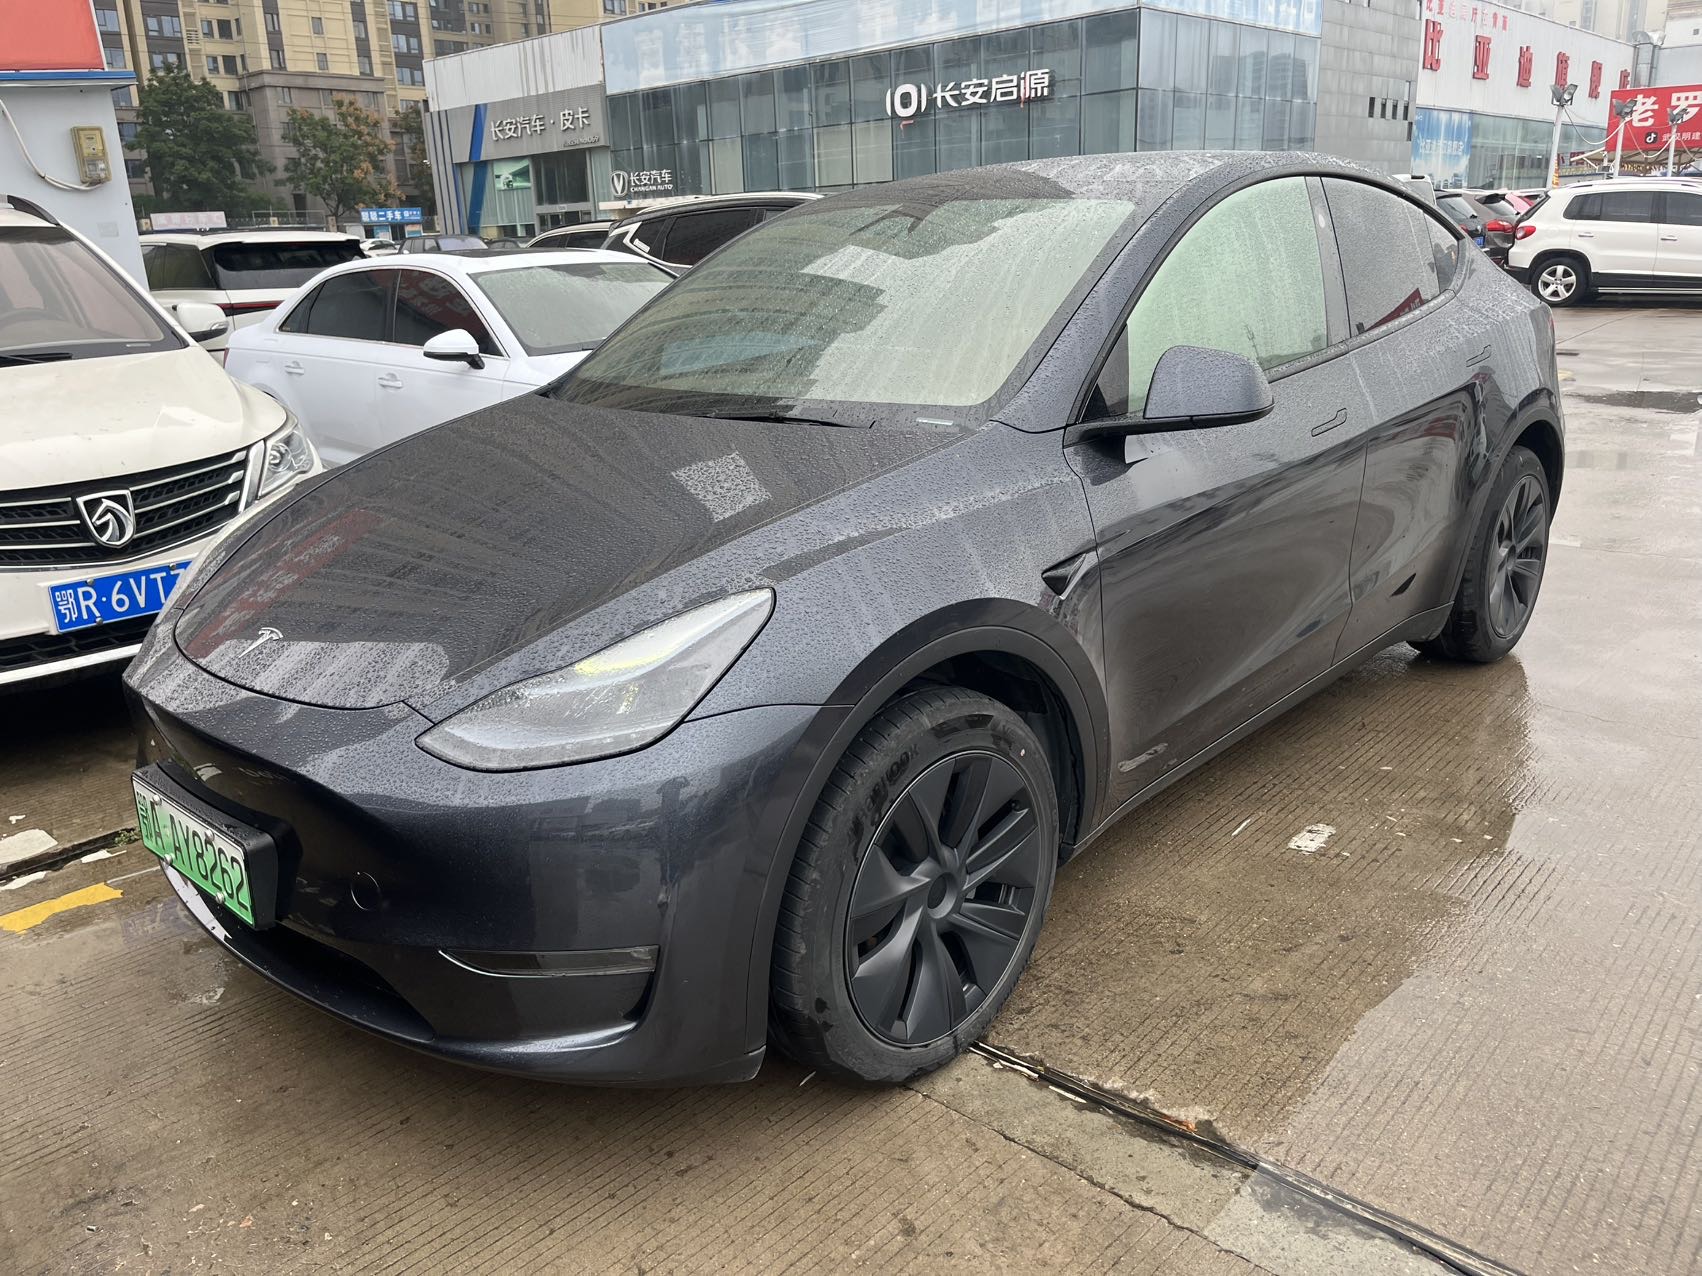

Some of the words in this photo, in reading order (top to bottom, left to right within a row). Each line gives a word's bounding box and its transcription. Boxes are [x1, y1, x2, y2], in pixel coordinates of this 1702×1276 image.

[933, 69, 1050, 108] 长安启源
[630, 169, 672, 185] 长安汽车
[630, 185, 656, 193] CHANGAN
